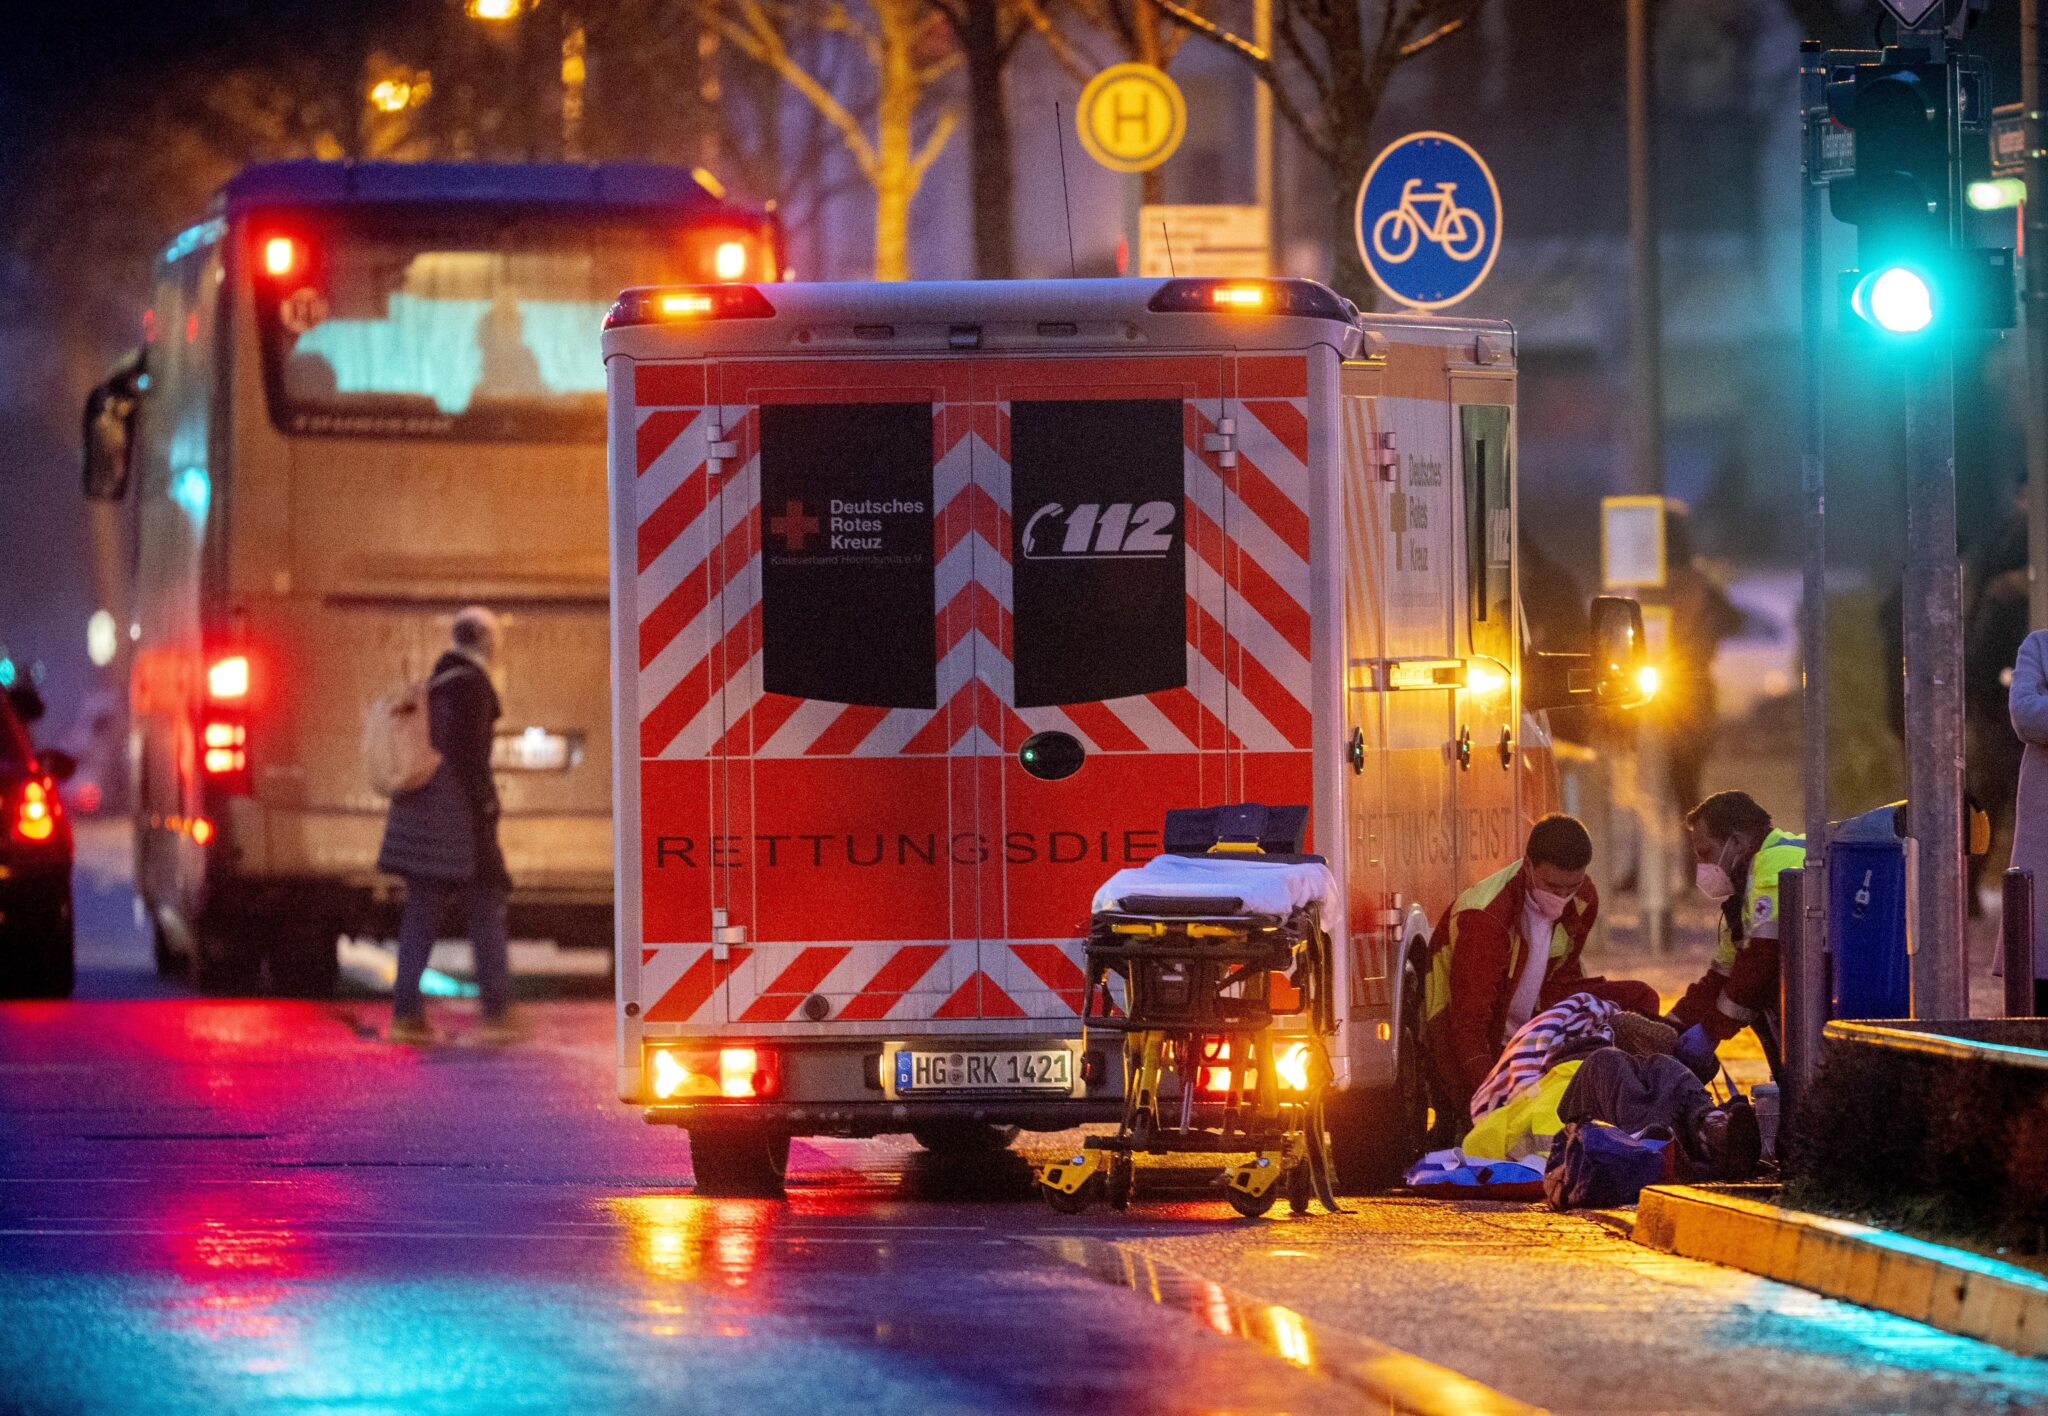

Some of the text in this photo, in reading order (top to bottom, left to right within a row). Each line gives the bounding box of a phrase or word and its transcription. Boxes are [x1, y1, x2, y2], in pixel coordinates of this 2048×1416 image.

[1113, 92, 1149, 143] H
[830, 499, 924, 514] Deutsches
[830, 516, 882, 532] Rotes
[1062, 501, 1176, 552] 112
[830, 534, 882, 549] Kreuz
[656, 829, 1160, 868] RETTUNGSDIE
[1356, 806, 1511, 867] RETTUNGSDIENST
[901, 1073, 908, 1083] D
[916, 1054, 1068, 1084] HG RK 1421
